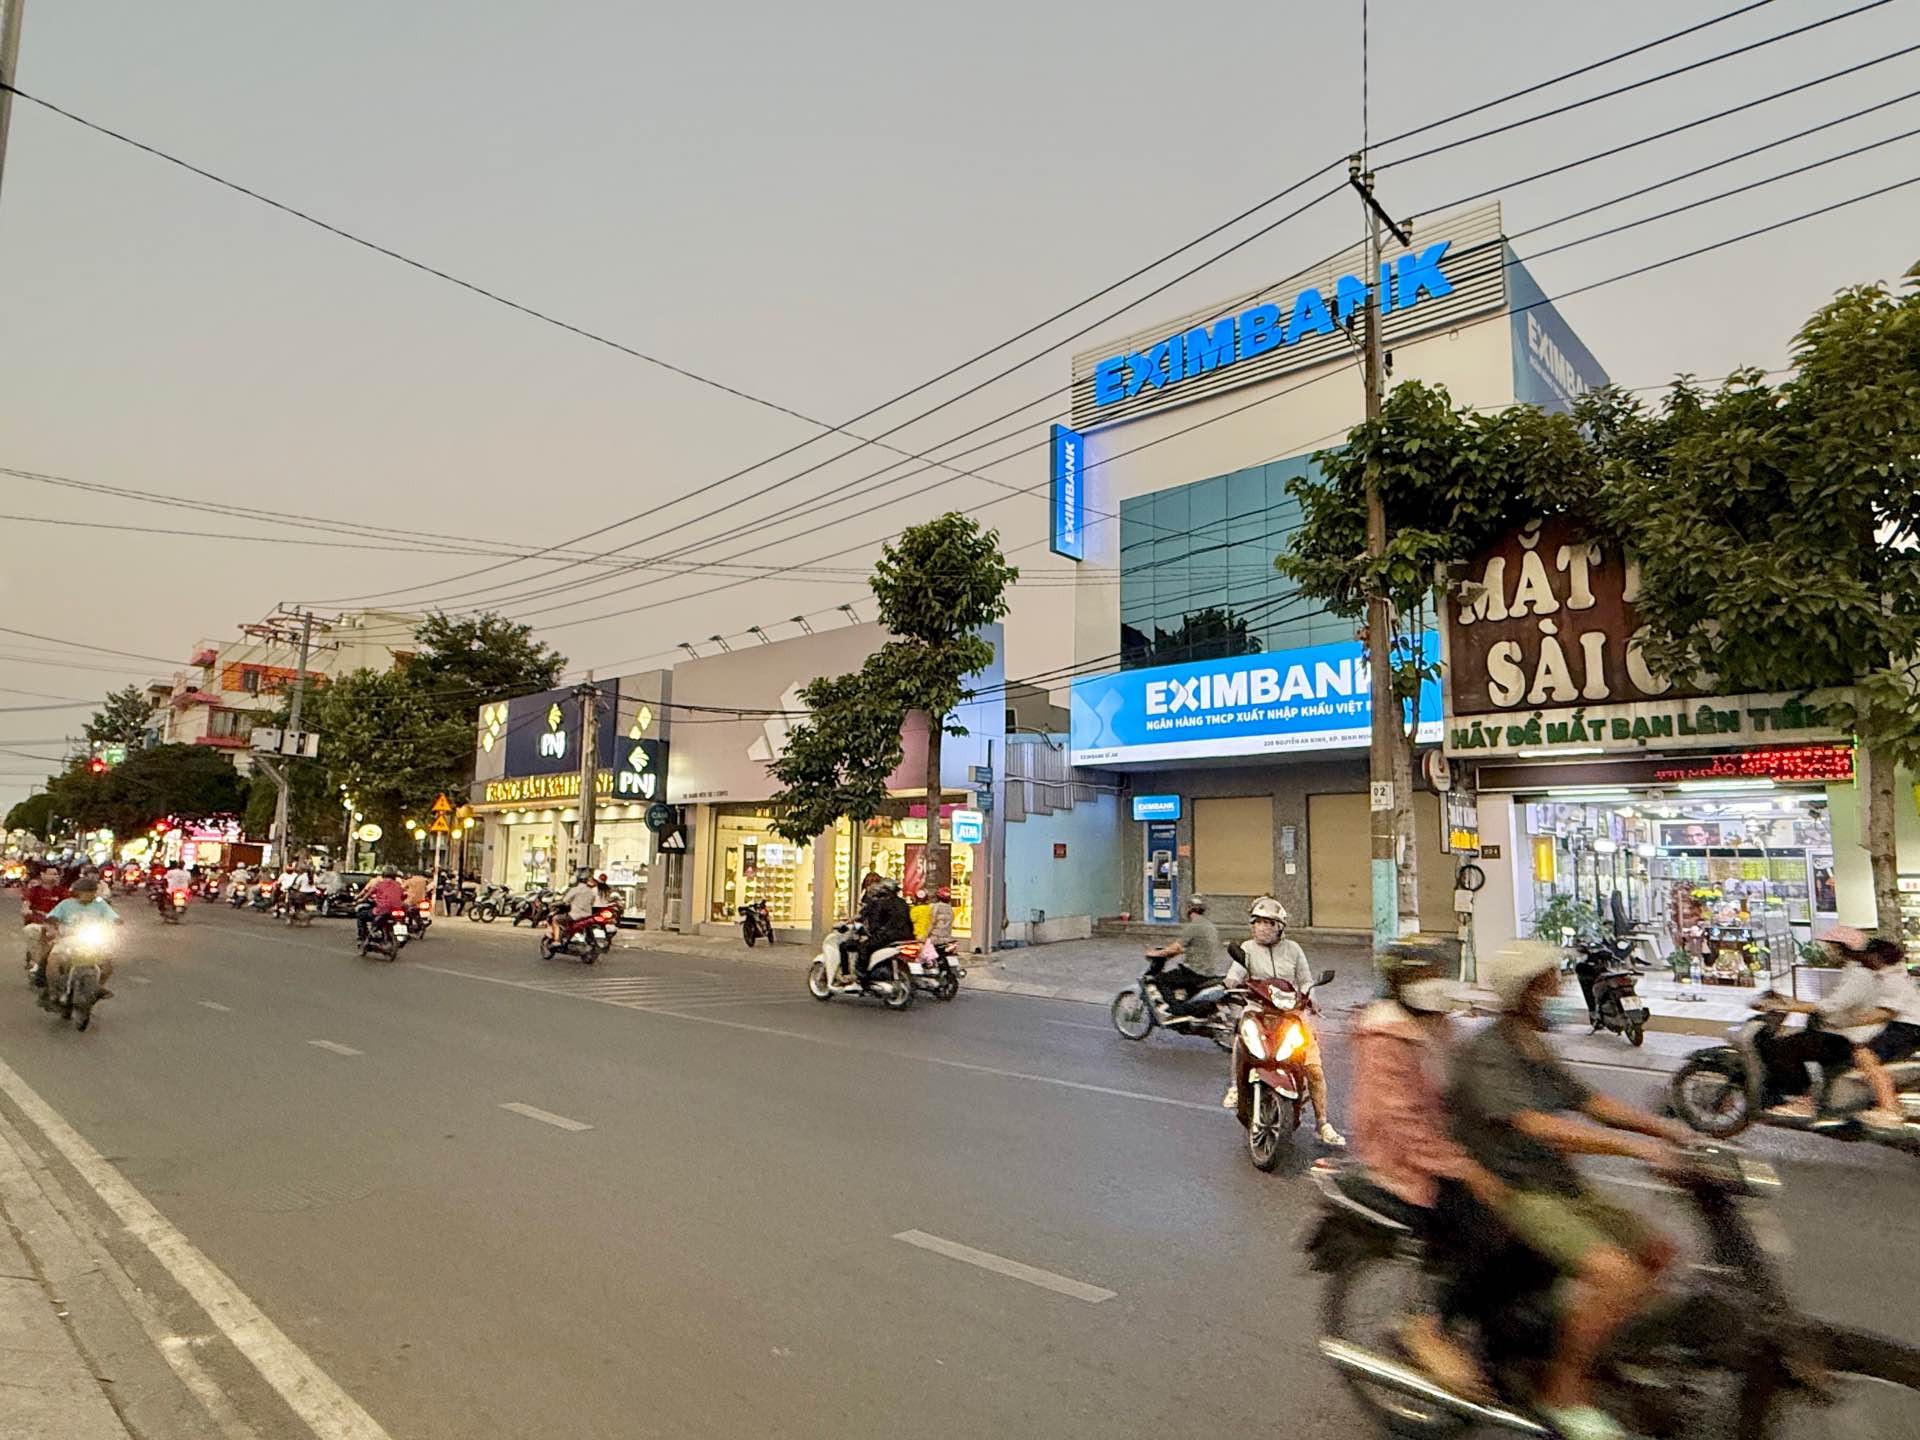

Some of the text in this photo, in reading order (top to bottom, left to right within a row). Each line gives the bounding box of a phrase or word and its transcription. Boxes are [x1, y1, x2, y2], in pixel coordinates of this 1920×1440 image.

[1094, 240, 1456, 407] EXIMBANK
[1065, 441, 1075, 545] EXIMBANK
[1487, 618, 1610, 708] SÀI
[1146, 715, 1173, 731] NGÂN
[1175, 713, 1203, 728] HÀNG
[1205, 713, 1234, 726] TMCP
[1236, 708, 1264, 723] XUẤT
[1267, 706, 1298, 722] NHẬP
[1335, 701, 1363, 717] VIỆT
[1451, 720, 1502, 749] HÃY
[1546, 707, 1606, 743] MẮT
[1611, 714, 1673, 746] BẠN
[1677, 705, 1740, 736] LÊN
[541, 731, 566, 759] PNJ
[619, 771, 657, 799] PNJ
